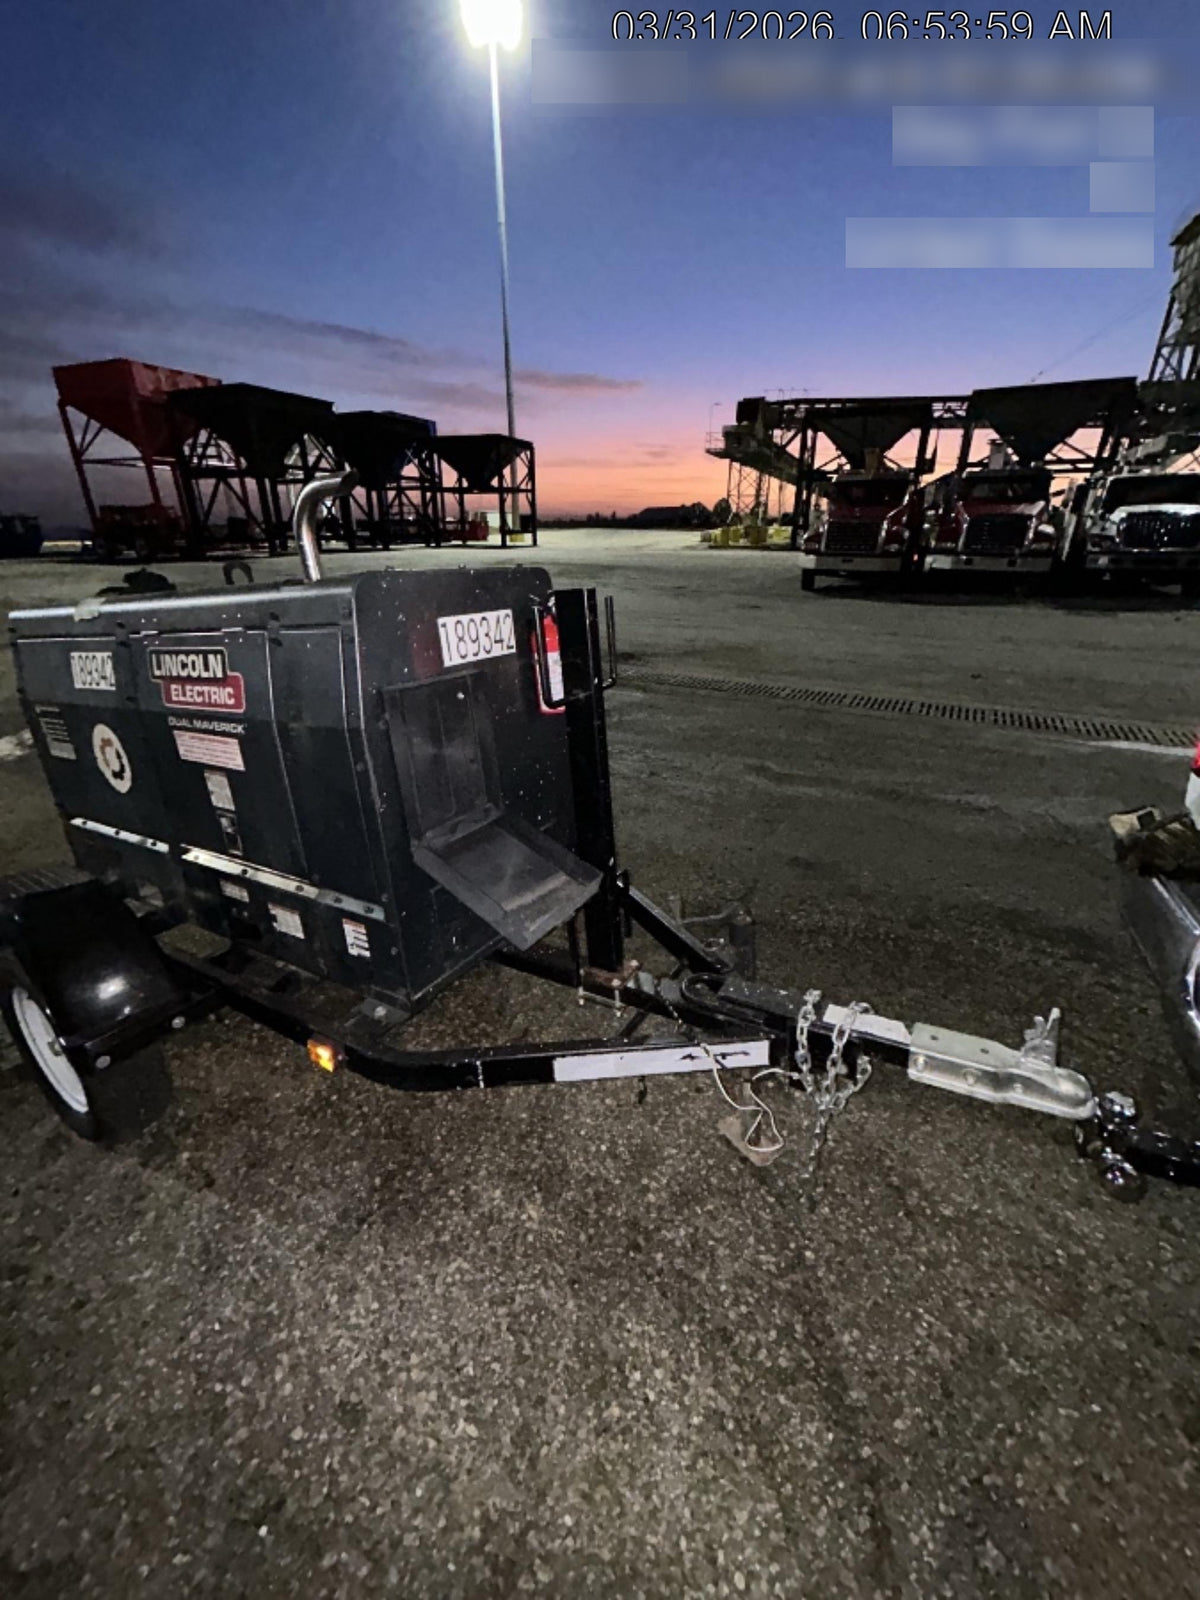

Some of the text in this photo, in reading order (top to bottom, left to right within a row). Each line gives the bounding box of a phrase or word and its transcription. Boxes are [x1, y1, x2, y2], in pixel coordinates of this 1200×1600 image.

[440, 612, 515, 662] 189342
[151, 653, 224, 678] LINCOLN
[169, 684, 236, 705] ELECTRIC
[168, 716, 245, 735] DUAL MAVERICK
